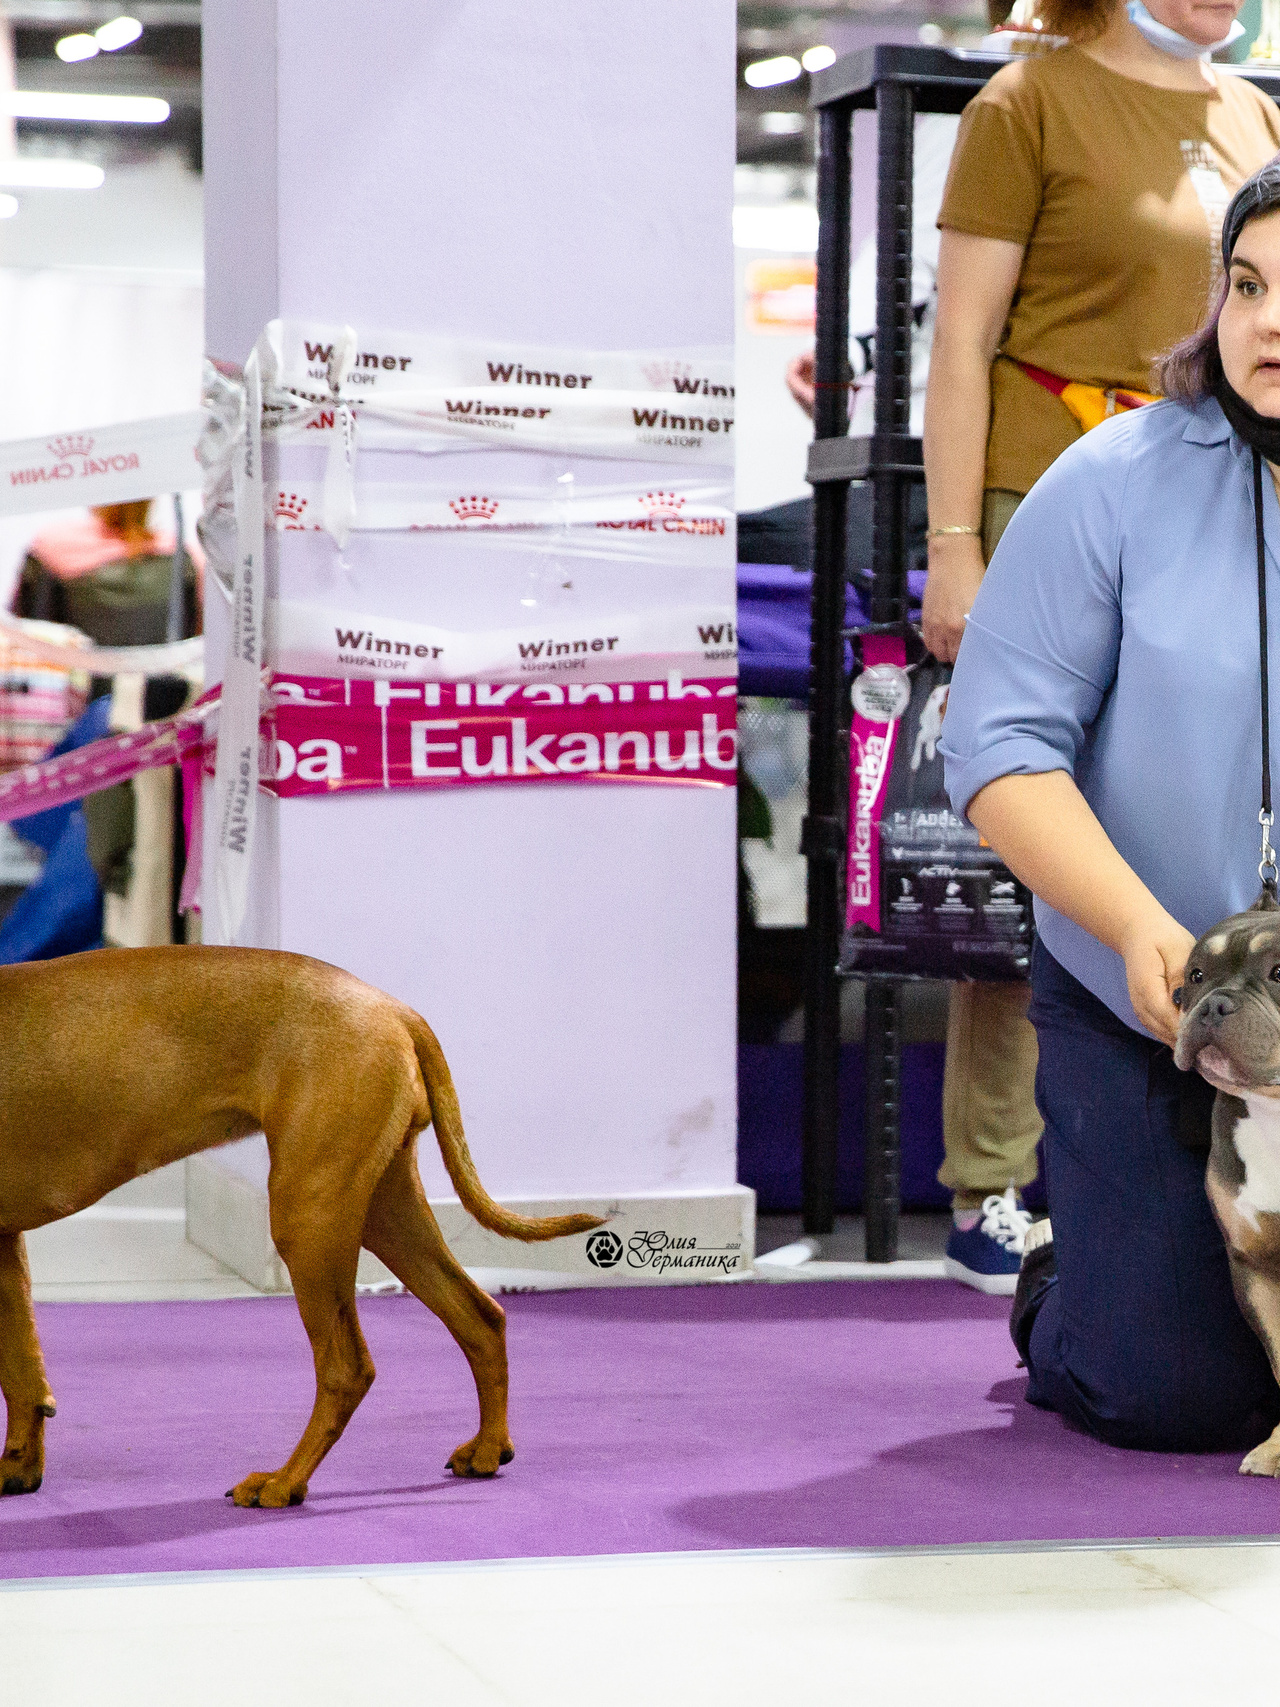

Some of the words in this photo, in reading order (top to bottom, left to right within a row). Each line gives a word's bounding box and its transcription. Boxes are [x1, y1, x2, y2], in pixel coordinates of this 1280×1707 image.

[304, 340, 412, 371] Wner
[487, 360, 593, 389] Winner
[445, 399, 552, 418] Winner
[632, 407, 735, 433] Winner
[336, 627, 444, 659] Winner
[518, 636, 619, 658] Winner
